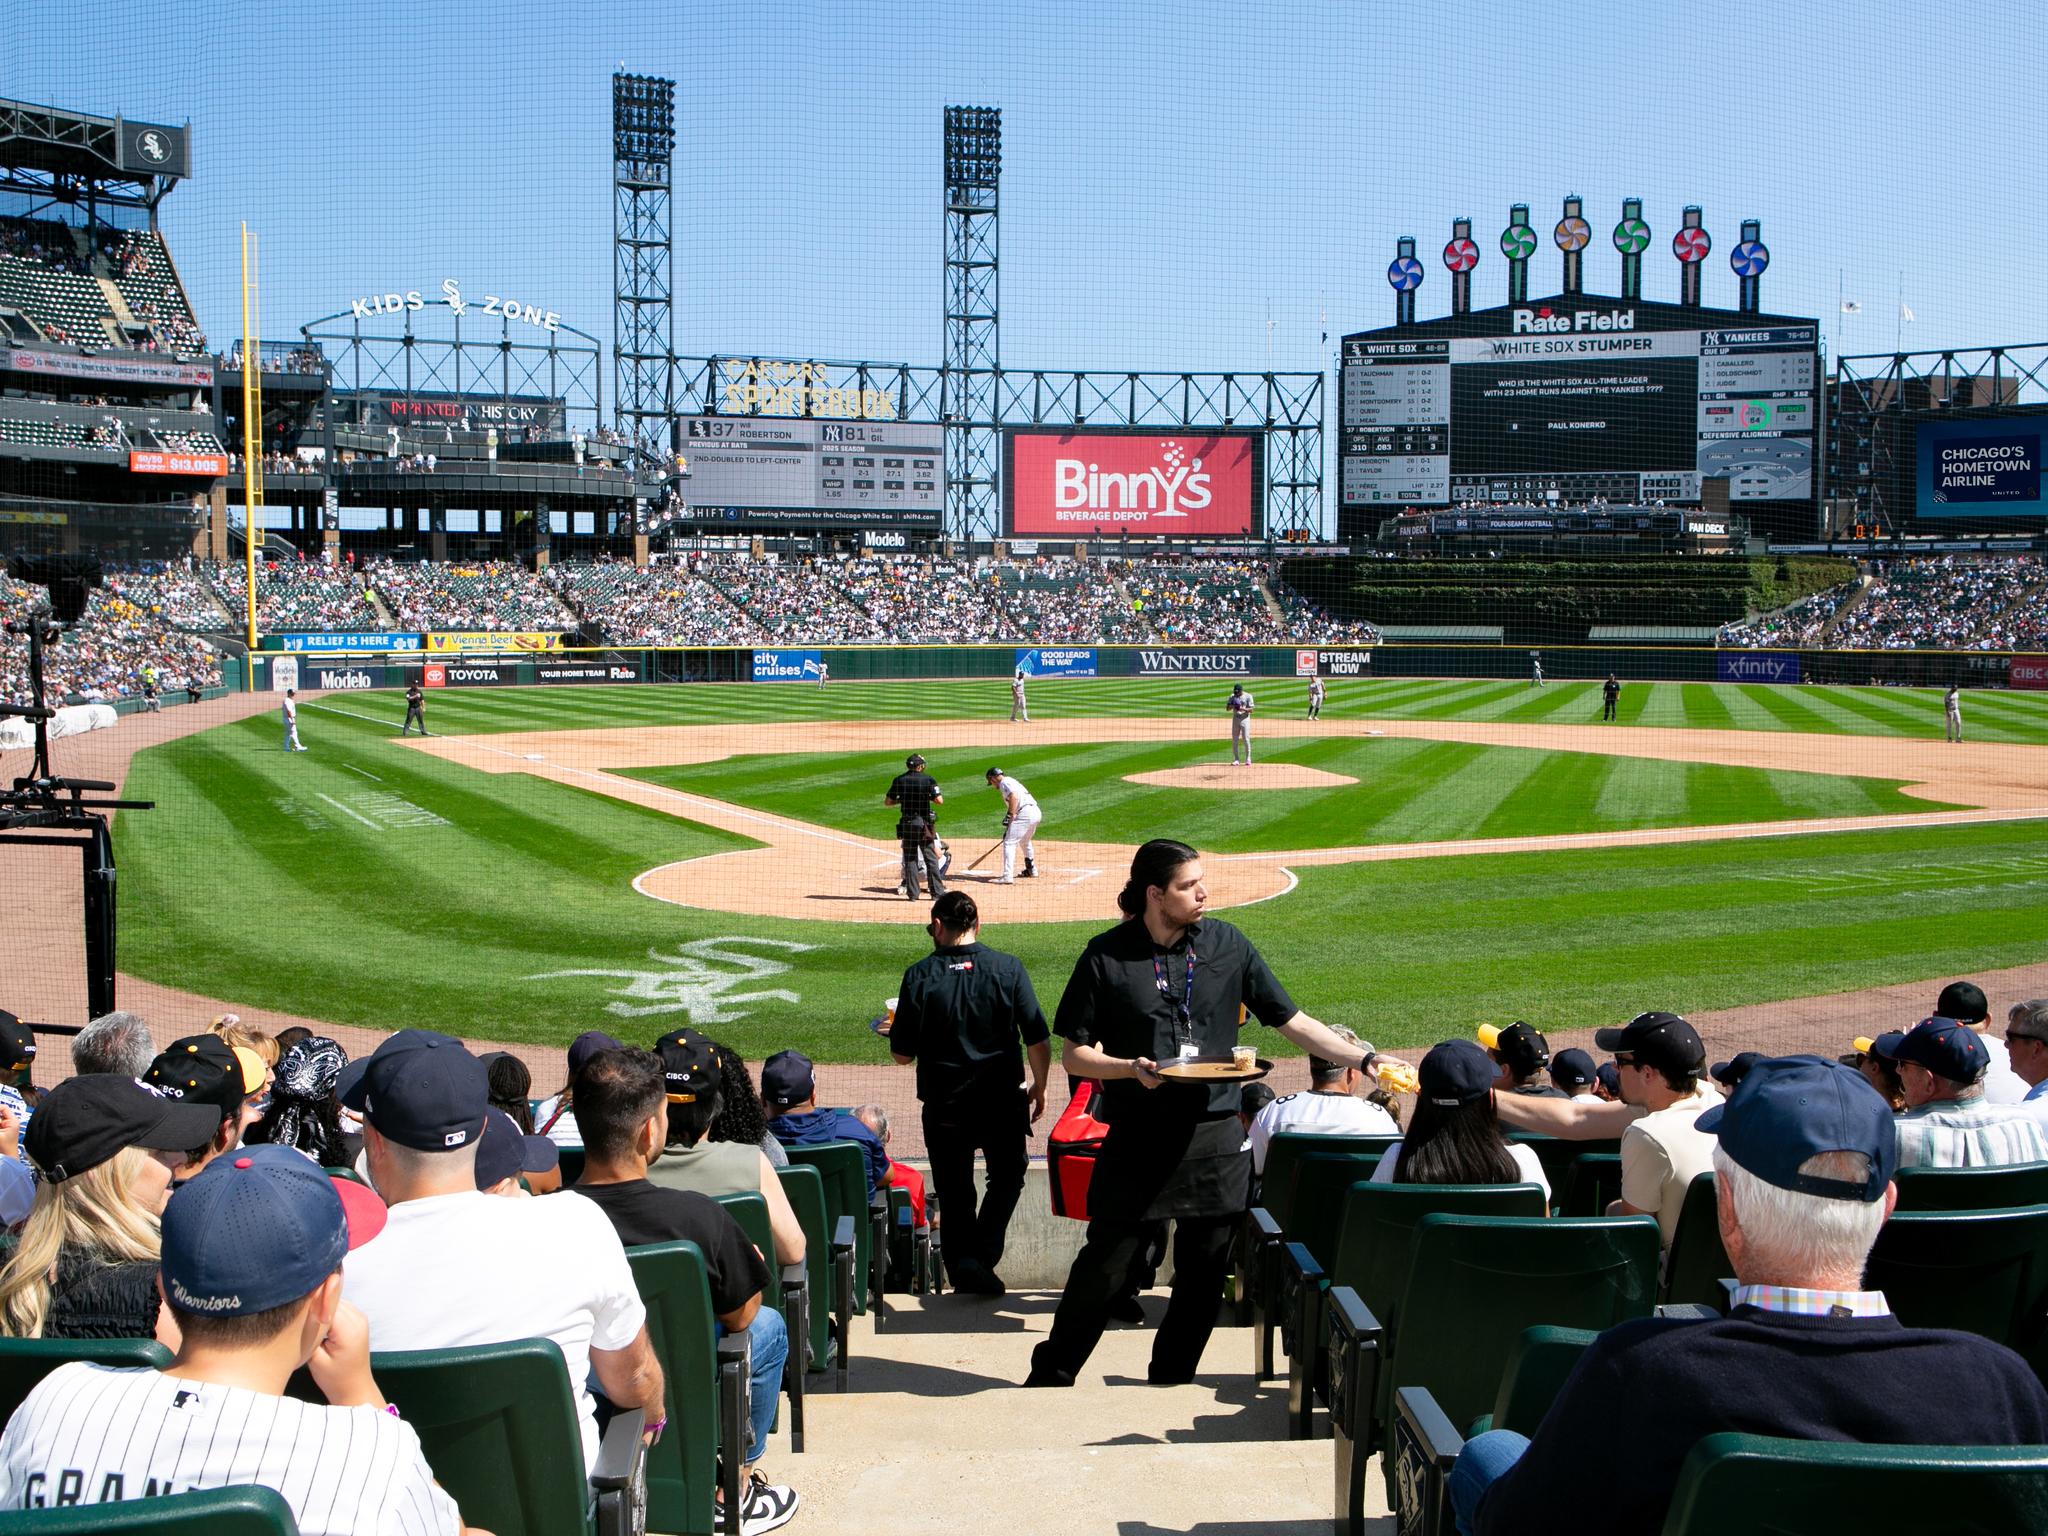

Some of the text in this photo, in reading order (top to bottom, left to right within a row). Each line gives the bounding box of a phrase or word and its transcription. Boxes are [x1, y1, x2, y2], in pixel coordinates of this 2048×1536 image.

[351, 291, 562, 333] KIDS ZONE
[1513, 309, 1634, 333] Rate Field
[1724, 332, 1770, 342] YANKEES
[1367, 344, 1417, 354] WHITE SOX
[1493, 338, 1652, 354] WHITE SOX STUMPER
[725, 360, 828, 382] CAESARS
[726, 384, 896, 418] SPORTSBOOK
[391, 402, 538, 421] IMPRINTED IN HISTORY
[712, 423, 734, 437] 37
[740, 430, 792, 440] ROBERTSON
[845, 427, 866, 441] 81
[1942, 446, 2024, 460] CHICAGO'S
[170, 458, 218, 472] $13,005
[1942, 460, 2031, 474] HOMETOWN
[1942, 475, 1996, 488] AIRLINE
[1454, 488, 1474, 498] 1-2
[748, 510, 779, 519] Powering
[780, 512, 811, 520] Payments
[1056, 512, 1149, 521] BEVERAGE DEPOT
[1400, 527, 1411, 536] FAN
[1689, 523, 1724, 534] FAN DECK
[865, 532, 905, 547] Modelo
[307, 636, 389, 646] RELIEF IS HERE
[451, 634, 513, 644] Vienna Beef
[754, 653, 778, 665] city
[1140, 651, 1250, 670] WINTRUST
[1319, 652, 1370, 663] STREAM
[1968, 658, 1998, 669] THE
[610, 667, 636, 679] Rate
[1331, 664, 1360, 674] NOW
[1727, 658, 1786, 679] xfinity
[2013, 668, 2043, 679] CIBC
[321, 670, 371, 689] Modelo
[449, 670, 498, 681] TOYOTA
[171, 1278, 242, 1311] Warriors
